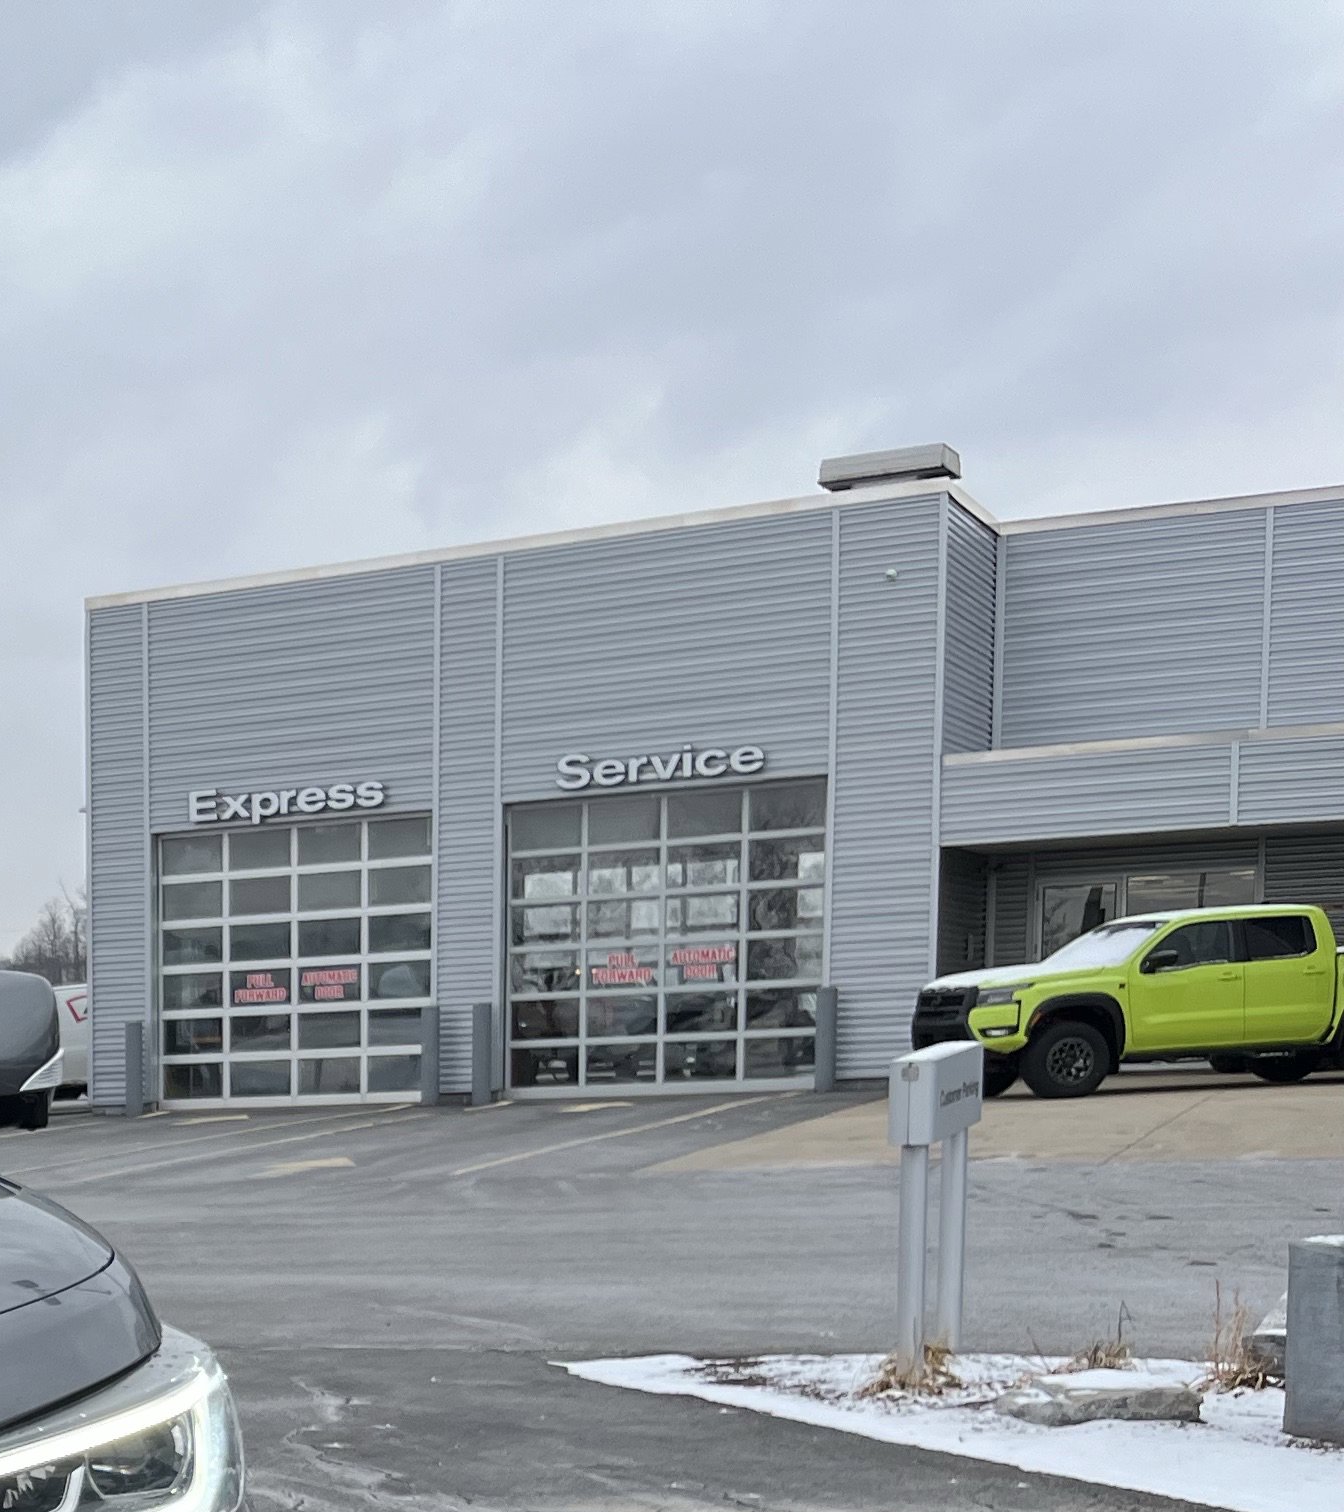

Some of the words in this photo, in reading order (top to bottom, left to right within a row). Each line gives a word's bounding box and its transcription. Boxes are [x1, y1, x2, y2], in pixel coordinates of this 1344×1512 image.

[188, 781, 386, 825] Express
[555, 744, 766, 790] Service
[670, 946, 736, 965] AUTOMATIC
[592, 967, 653, 985] FORWARD
